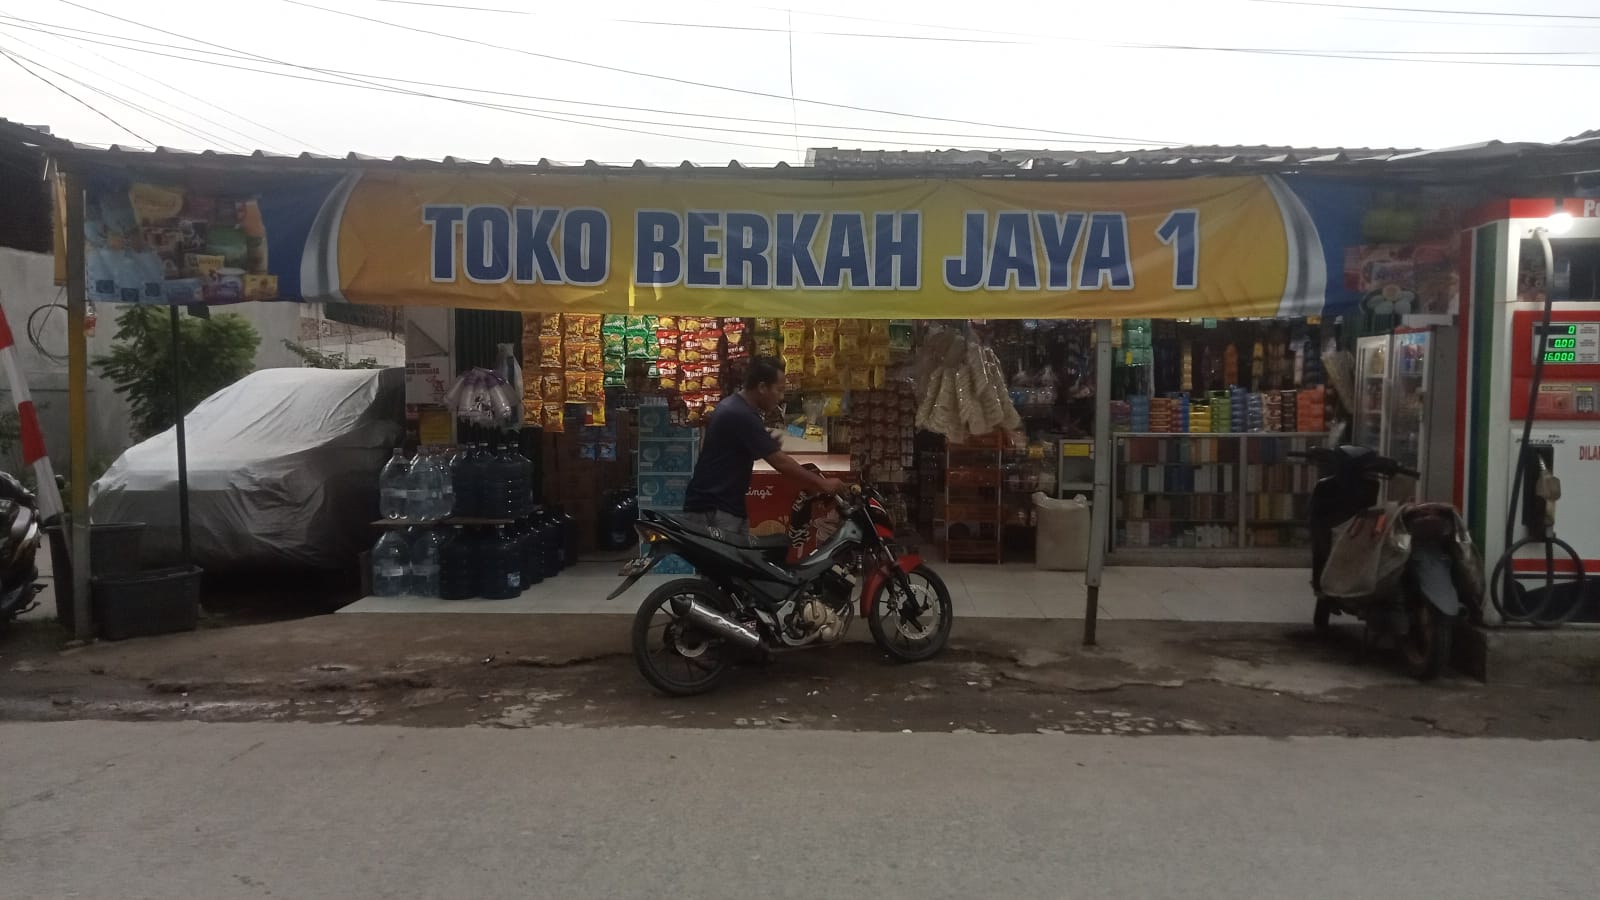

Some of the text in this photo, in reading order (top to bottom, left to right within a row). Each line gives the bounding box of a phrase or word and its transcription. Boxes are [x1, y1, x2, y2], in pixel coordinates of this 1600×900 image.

[423, 204, 1198, 291] TOKO BERKAH JAYA 1
[1568, 325, 1576, 335] 0
[1554, 339, 1575, 348] 0.00
[1544, 352, 1574, 361] 16.000
[1579, 445, 1600, 460] DILA
[745, 486, 773, 499] ings
